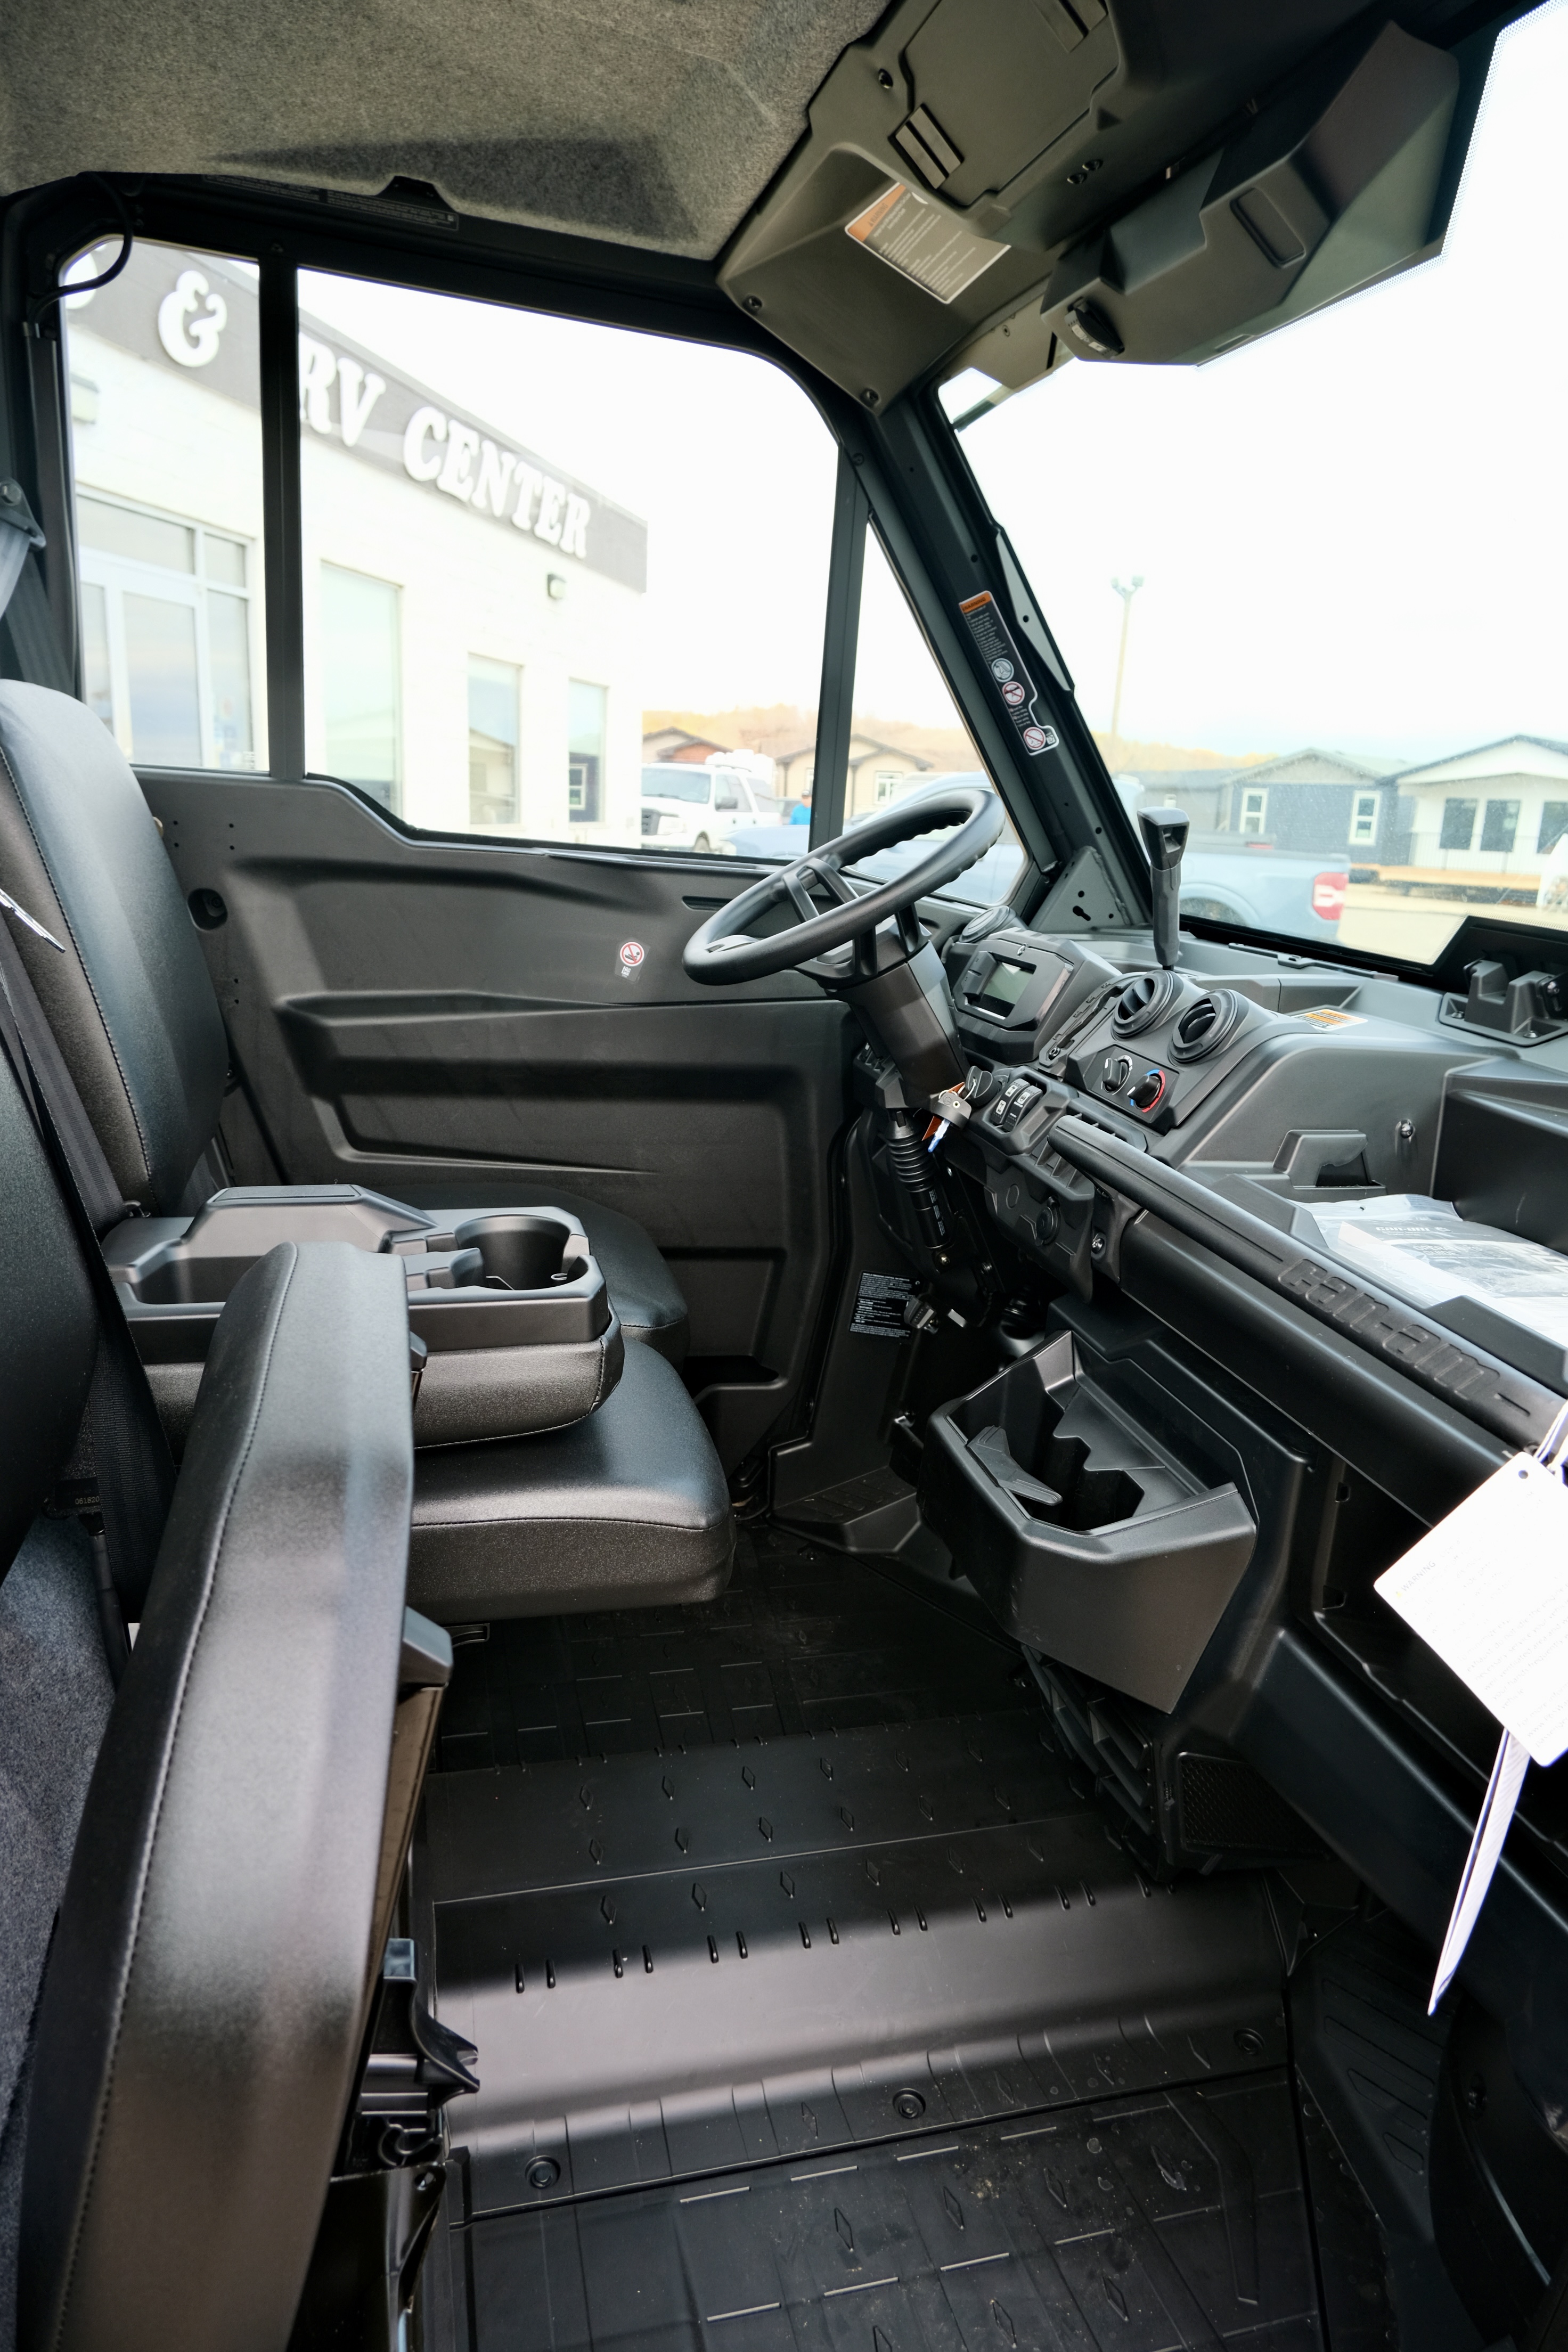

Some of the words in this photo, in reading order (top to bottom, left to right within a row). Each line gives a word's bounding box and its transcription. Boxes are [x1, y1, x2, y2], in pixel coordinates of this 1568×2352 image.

[158, 270, 227, 368] &
[299, 336, 387, 447] RV
[402, 405, 592, 559] CENTER
[75, 1496, 100, 1505] 061820
[1401, 1560, 1436, 1591] WARNING
